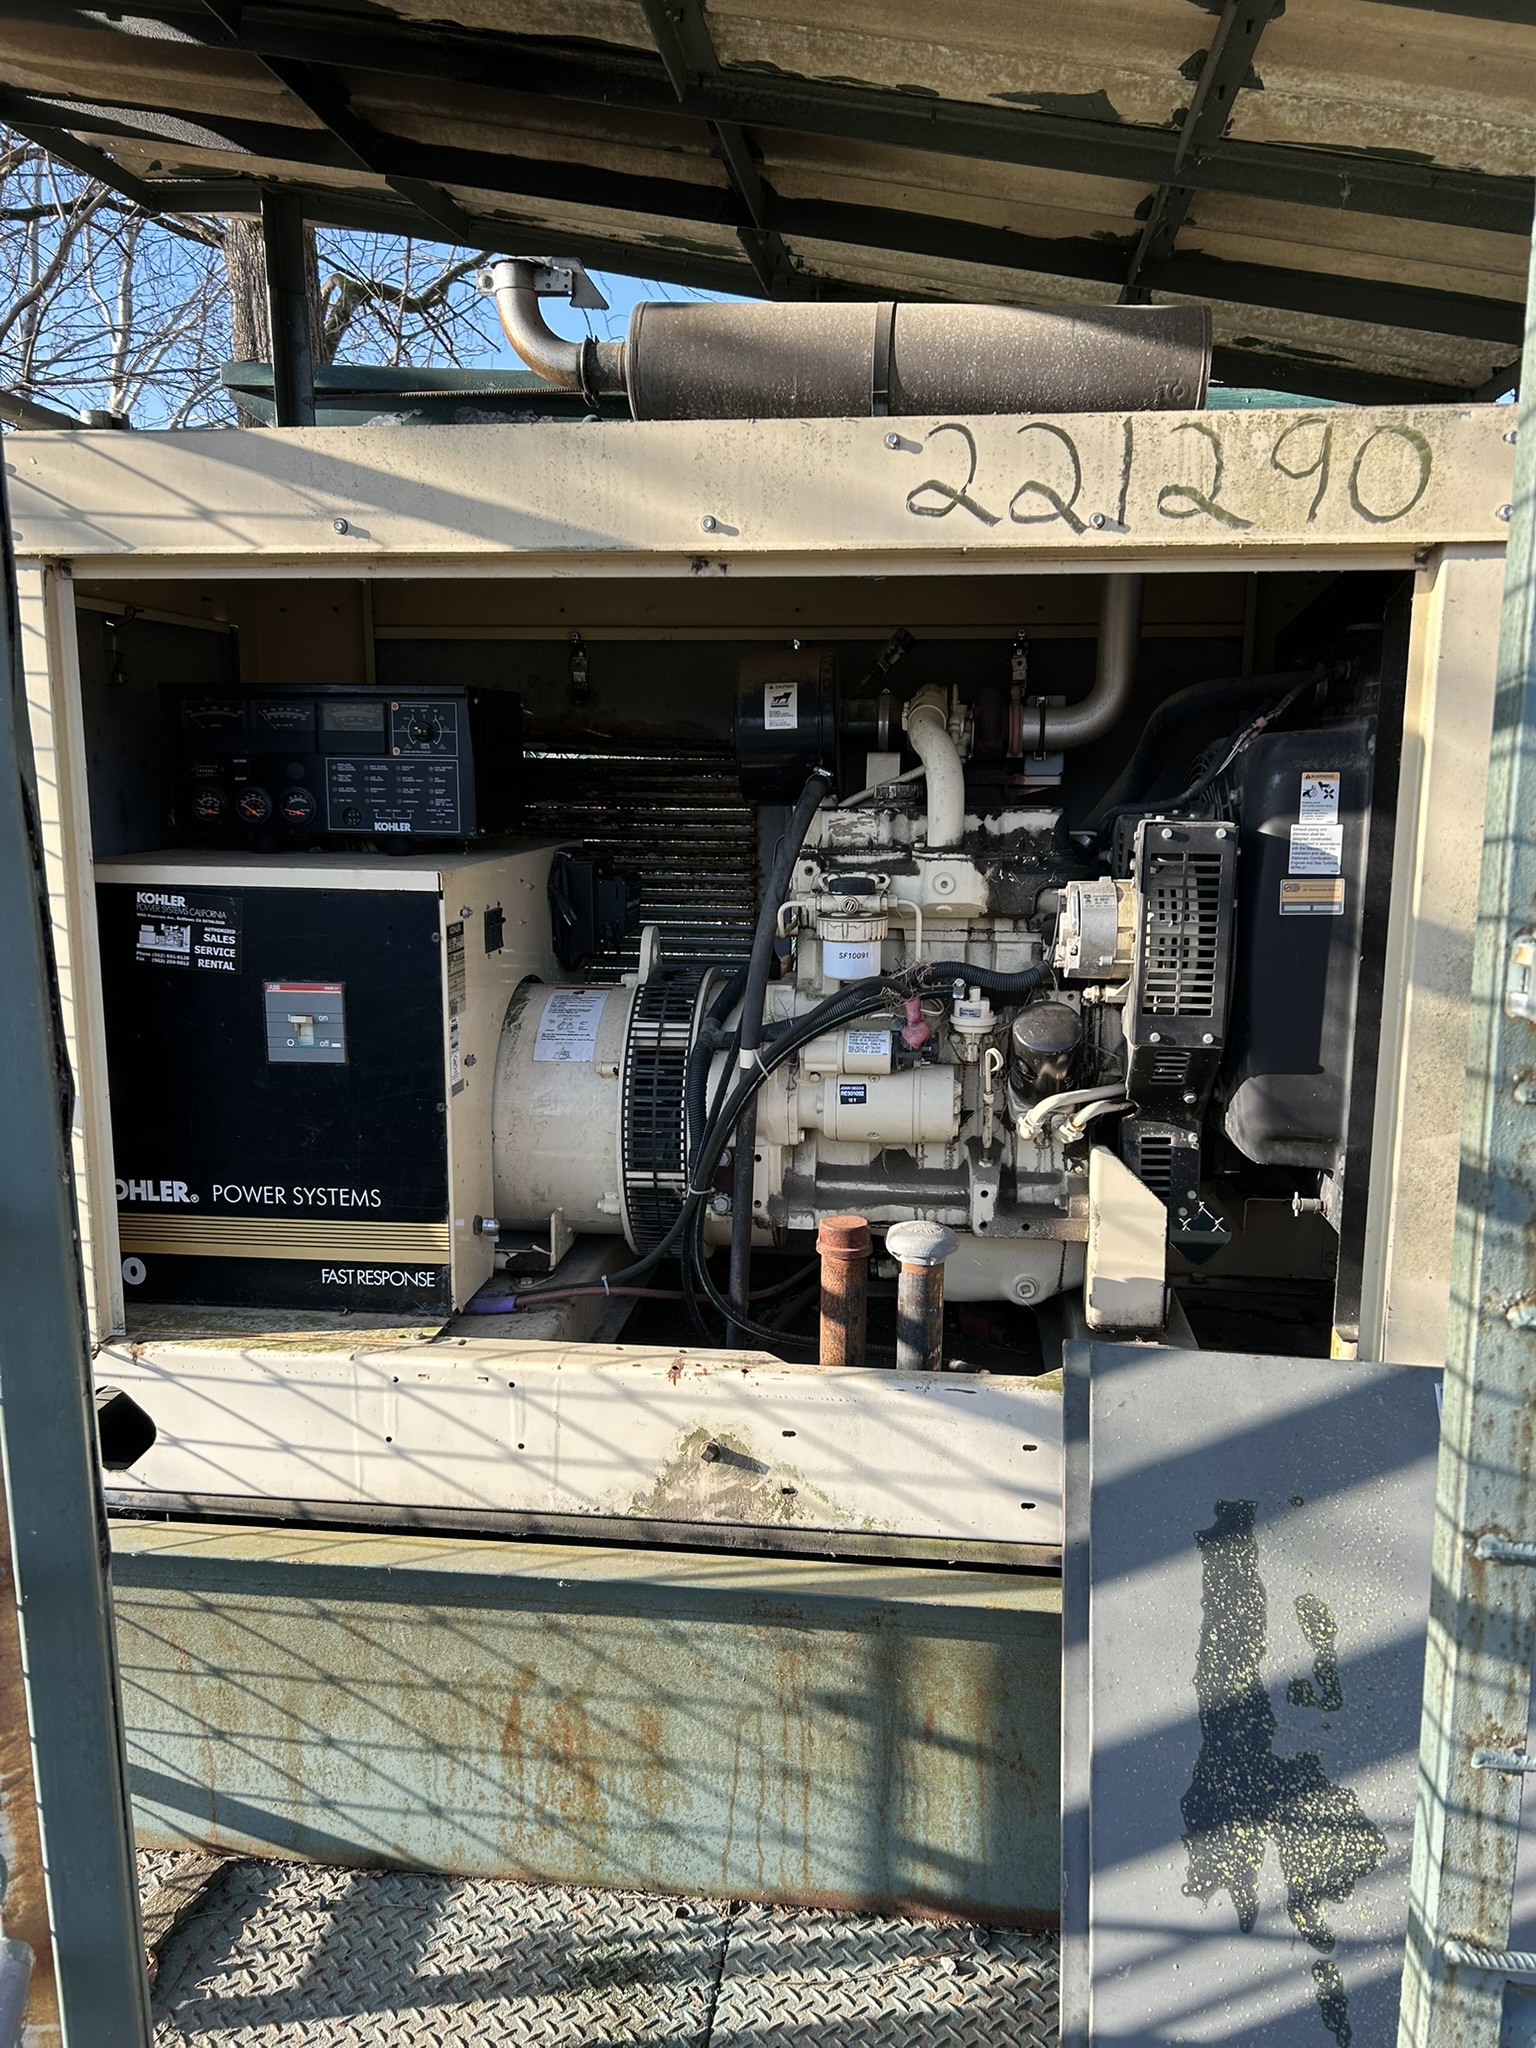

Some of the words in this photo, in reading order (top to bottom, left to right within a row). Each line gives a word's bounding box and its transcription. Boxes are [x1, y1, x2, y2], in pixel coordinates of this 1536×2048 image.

[905, 417, 1432, 534] 221290
[374, 821, 411, 832] KOHLER
[136, 891, 187, 907] KOHLER
[136, 903, 160, 912] POWER
[161, 905, 189, 916] SYSTEMS
[189, 908, 227, 919] CALIFORNIA
[203, 933, 236, 944] SALES
[194, 945, 236, 957] SERVICE
[838, 951, 869, 960] SF10091
[197, 958, 236, 971] RENTAL
[212, 1184, 287, 1206] POWER
[292, 1187, 381, 1208] SYSTEMS
[321, 1268, 355, 1284] FAST
[356, 1269, 435, 1287] RESPONSE
